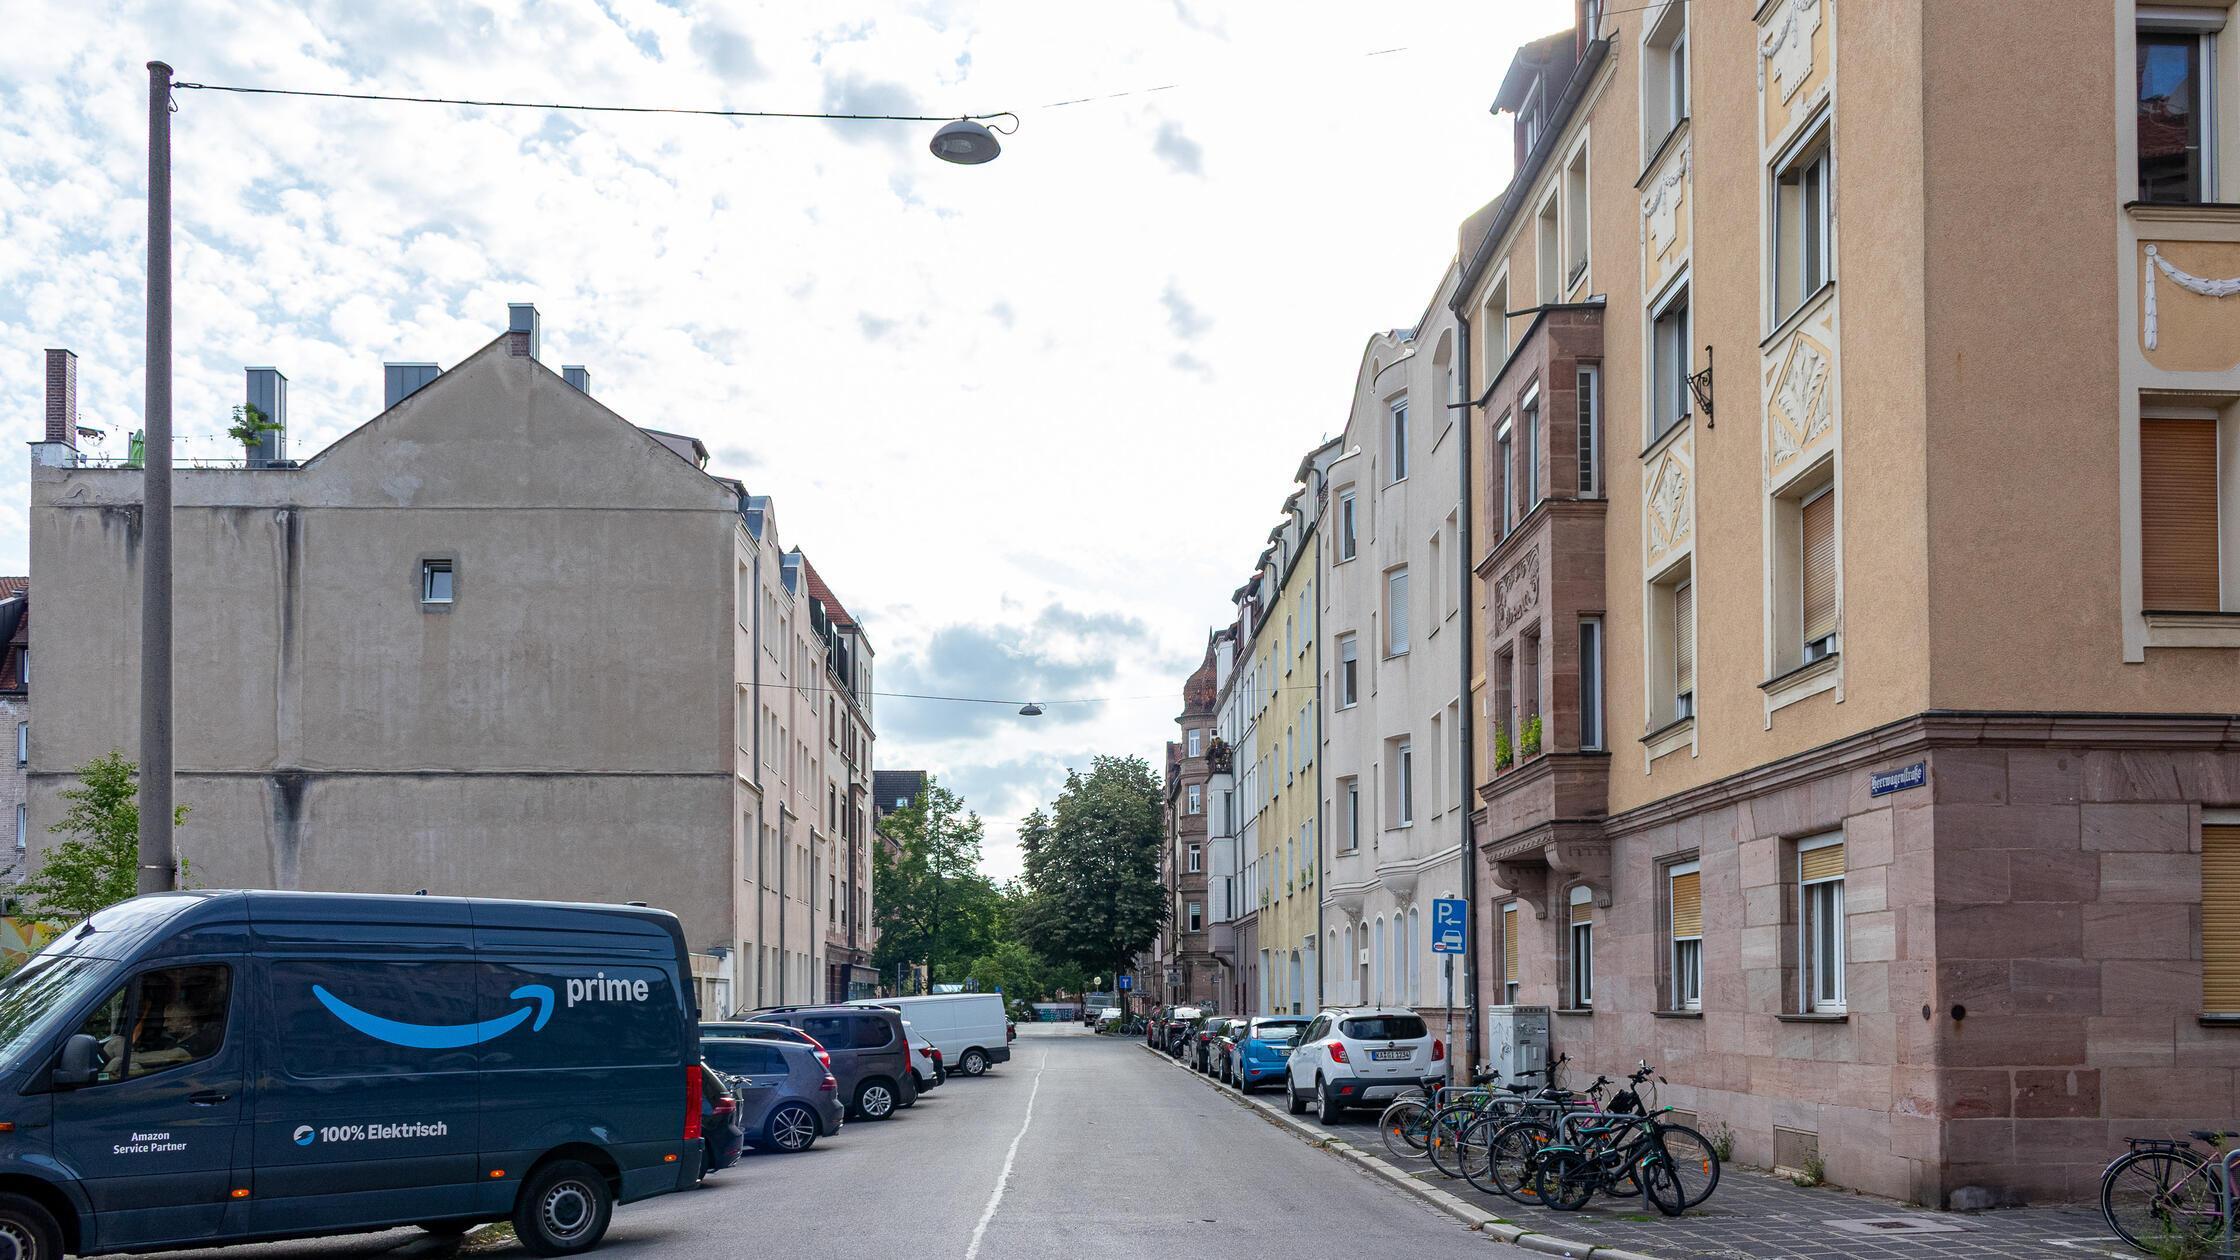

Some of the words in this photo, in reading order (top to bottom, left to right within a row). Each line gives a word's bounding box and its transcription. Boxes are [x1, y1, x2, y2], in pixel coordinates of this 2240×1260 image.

[1438, 902, 1453, 924] P
[566, 971, 649, 1008] prime
[131, 1132, 170, 1142] Amazon
[320, 1124, 366, 1143] 100%
[367, 1120, 448, 1140] Elektrisch
[113, 1143, 149, 1155] Service
[150, 1143, 187, 1153] Partner
